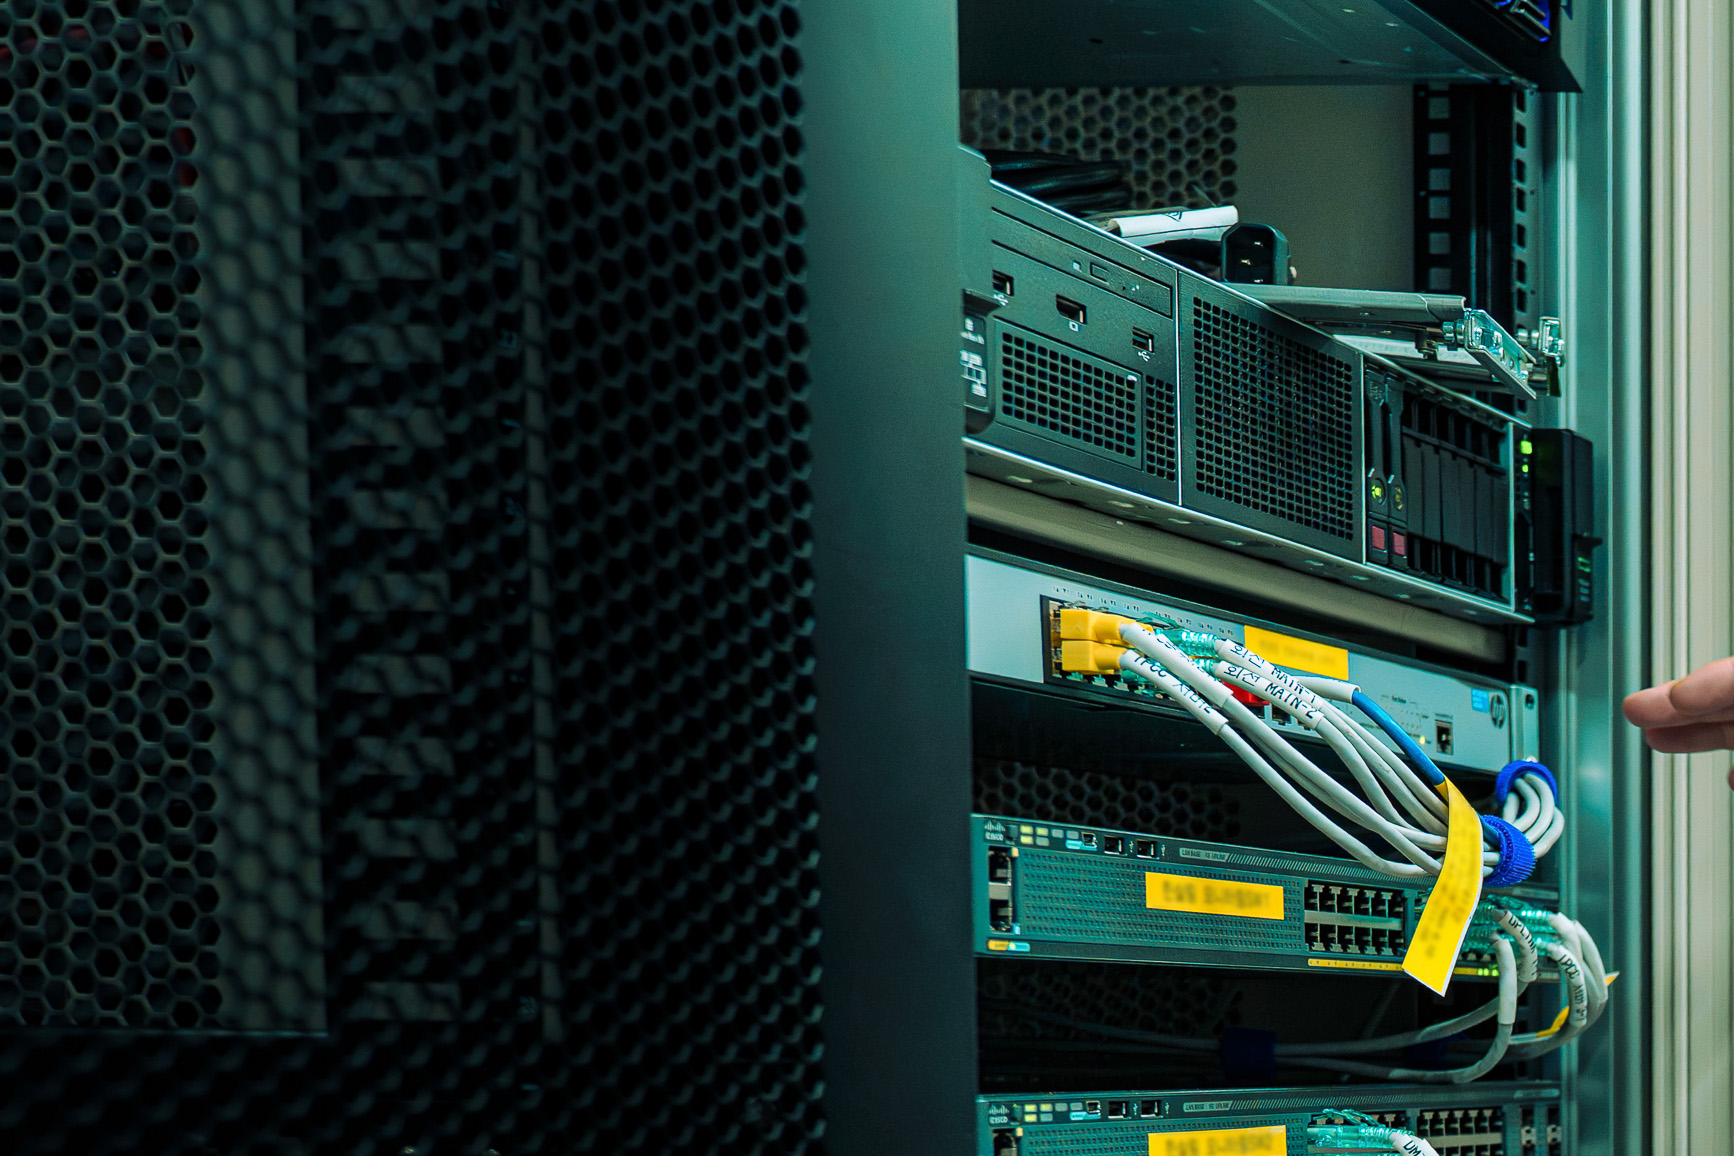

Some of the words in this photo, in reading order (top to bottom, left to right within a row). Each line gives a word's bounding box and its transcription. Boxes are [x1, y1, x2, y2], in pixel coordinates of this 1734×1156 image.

[1224, 666, 1261, 687] 회선
[1265, 683, 1319, 719] MAIN-2
[1230, 645, 1265, 668] 회선
[1271, 667, 1316, 703] MAIN-1
[1558, 954, 1581, 979] IPCC
